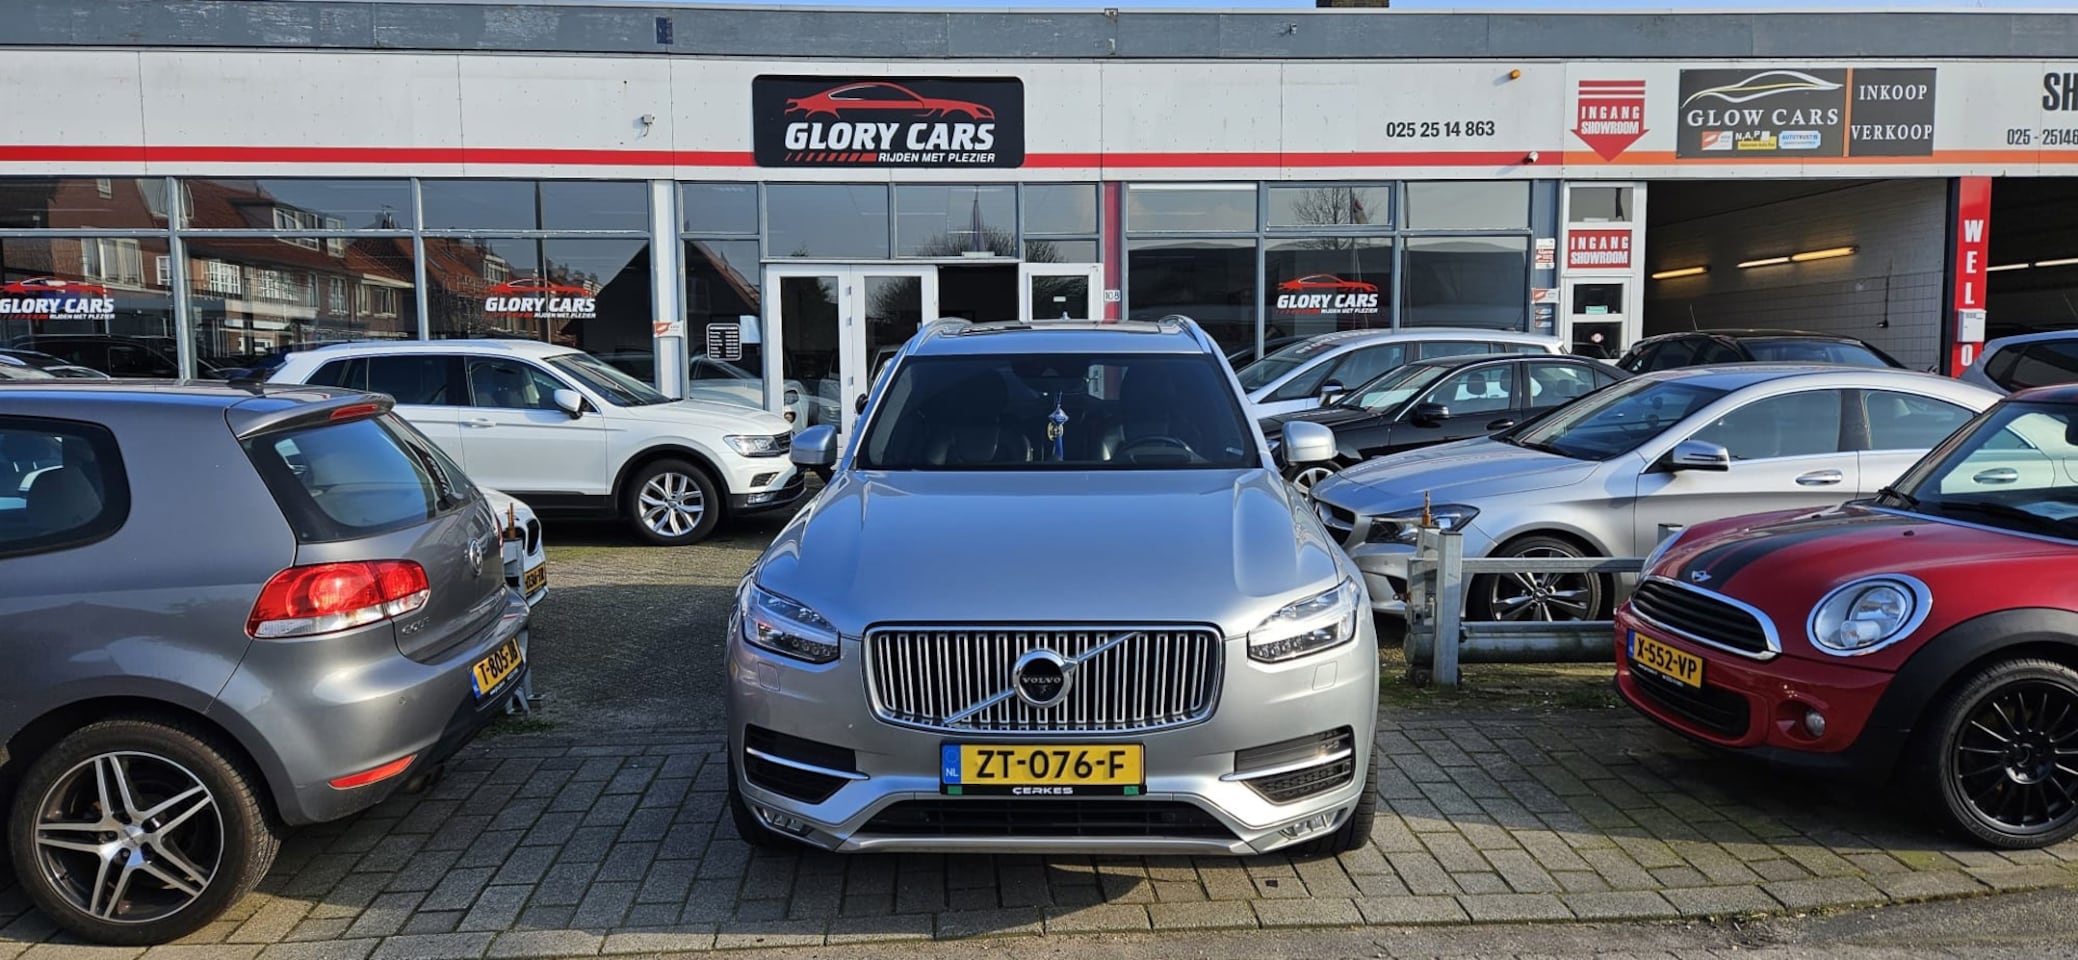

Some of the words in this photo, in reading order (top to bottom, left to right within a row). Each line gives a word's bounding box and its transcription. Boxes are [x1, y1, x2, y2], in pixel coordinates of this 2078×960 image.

[1858, 84, 1929, 101] INKOOP
[2042, 72, 2078, 112] SH
[1581, 105, 1640, 120] INGANG
[1686, 108, 1764, 127] GLOW
[1771, 108, 1840, 126] CARS
[784, 122, 900, 151] GLORY
[905, 122, 996, 151] CARS
[1386, 121, 1416, 138] 025
[1420, 121, 1440, 138] 25
[1443, 121, 1462, 138] 14
[1465, 120, 1496, 137] 863
[1580, 121, 1640, 136] SHOWROOM
[1851, 123, 1934, 141] VERKOOP
[2007, 128, 2032, 145] 025
[878, 152, 920, 163] RIJDEN
[921, 152, 948, 163] MET
[947, 152, 996, 163] PLEZIER
[1570, 235, 1630, 250] INGANG
[1570, 251, 1629, 265] SHOWROOM
[0, 298, 61, 314] GLORY
[64, 298, 115, 314] CARS
[484, 296, 546, 313] GLORY
[548, 297, 597, 313] CARS
[1276, 294, 1333, 309] GLORY
[1334, 293, 1379, 309] CARS
[1637, 637, 1697, 680] X-552-VP
[1022, 676, 1062, 684] VOLVO
[945, 768, 959, 777] NL
[975, 749, 1127, 779] ZT-076-F
